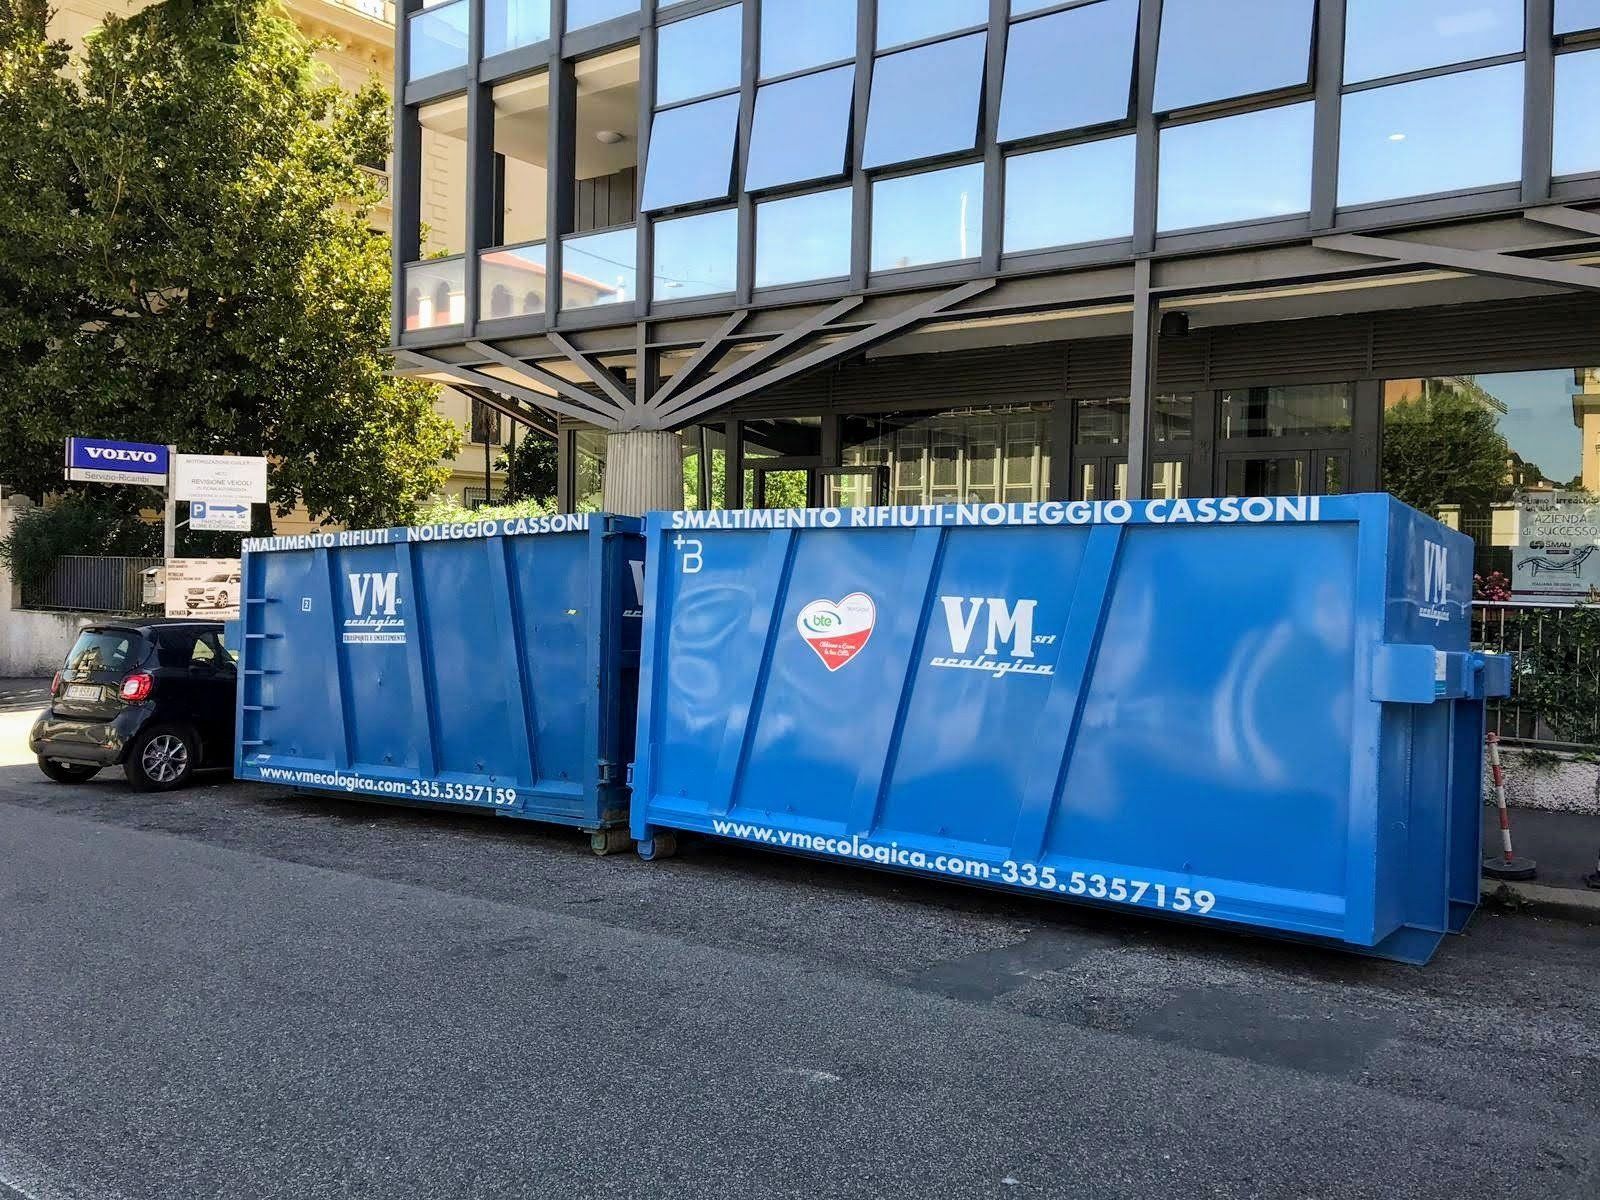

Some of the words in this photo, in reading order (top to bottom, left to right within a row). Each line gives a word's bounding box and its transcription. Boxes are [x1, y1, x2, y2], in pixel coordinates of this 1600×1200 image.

[84, 447, 157, 463] VOLVO
[84, 472, 150, 483] Servizio-Ricambi
[194, 503, 203, 516] P
[672, 508, 841, 529] SMALTIMENTO
[851, 501, 1132, 527] RIFIUTI-NOLEGGIO
[1144, 496, 1321, 523] CASSONI
[1535, 514, 1587, 524] AZIENDA
[241, 532, 335, 553] SMALTIMENTO
[339, 528, 389, 547] RIFIUTI
[407, 521, 498, 543] NOLEGGIO
[503, 512, 589, 536] CASSONI
[1522, 528, 1531, 536] di
[1537, 527, 1598, 536] SUCCESSO
[1424, 538, 1448, 605] VM
[348, 572, 399, 616] VM
[343, 615, 405, 632] ecologica
[813, 615, 832, 627] bte
[941, 596, 1038, 658] VM
[1032, 633, 1057, 645] srl
[929, 655, 1056, 679] ecologica
[260, 766, 516, 805] www.vmecologica.com-335.5357159
[712, 818, 1216, 914] www.vmecologica.com-335.5357159
